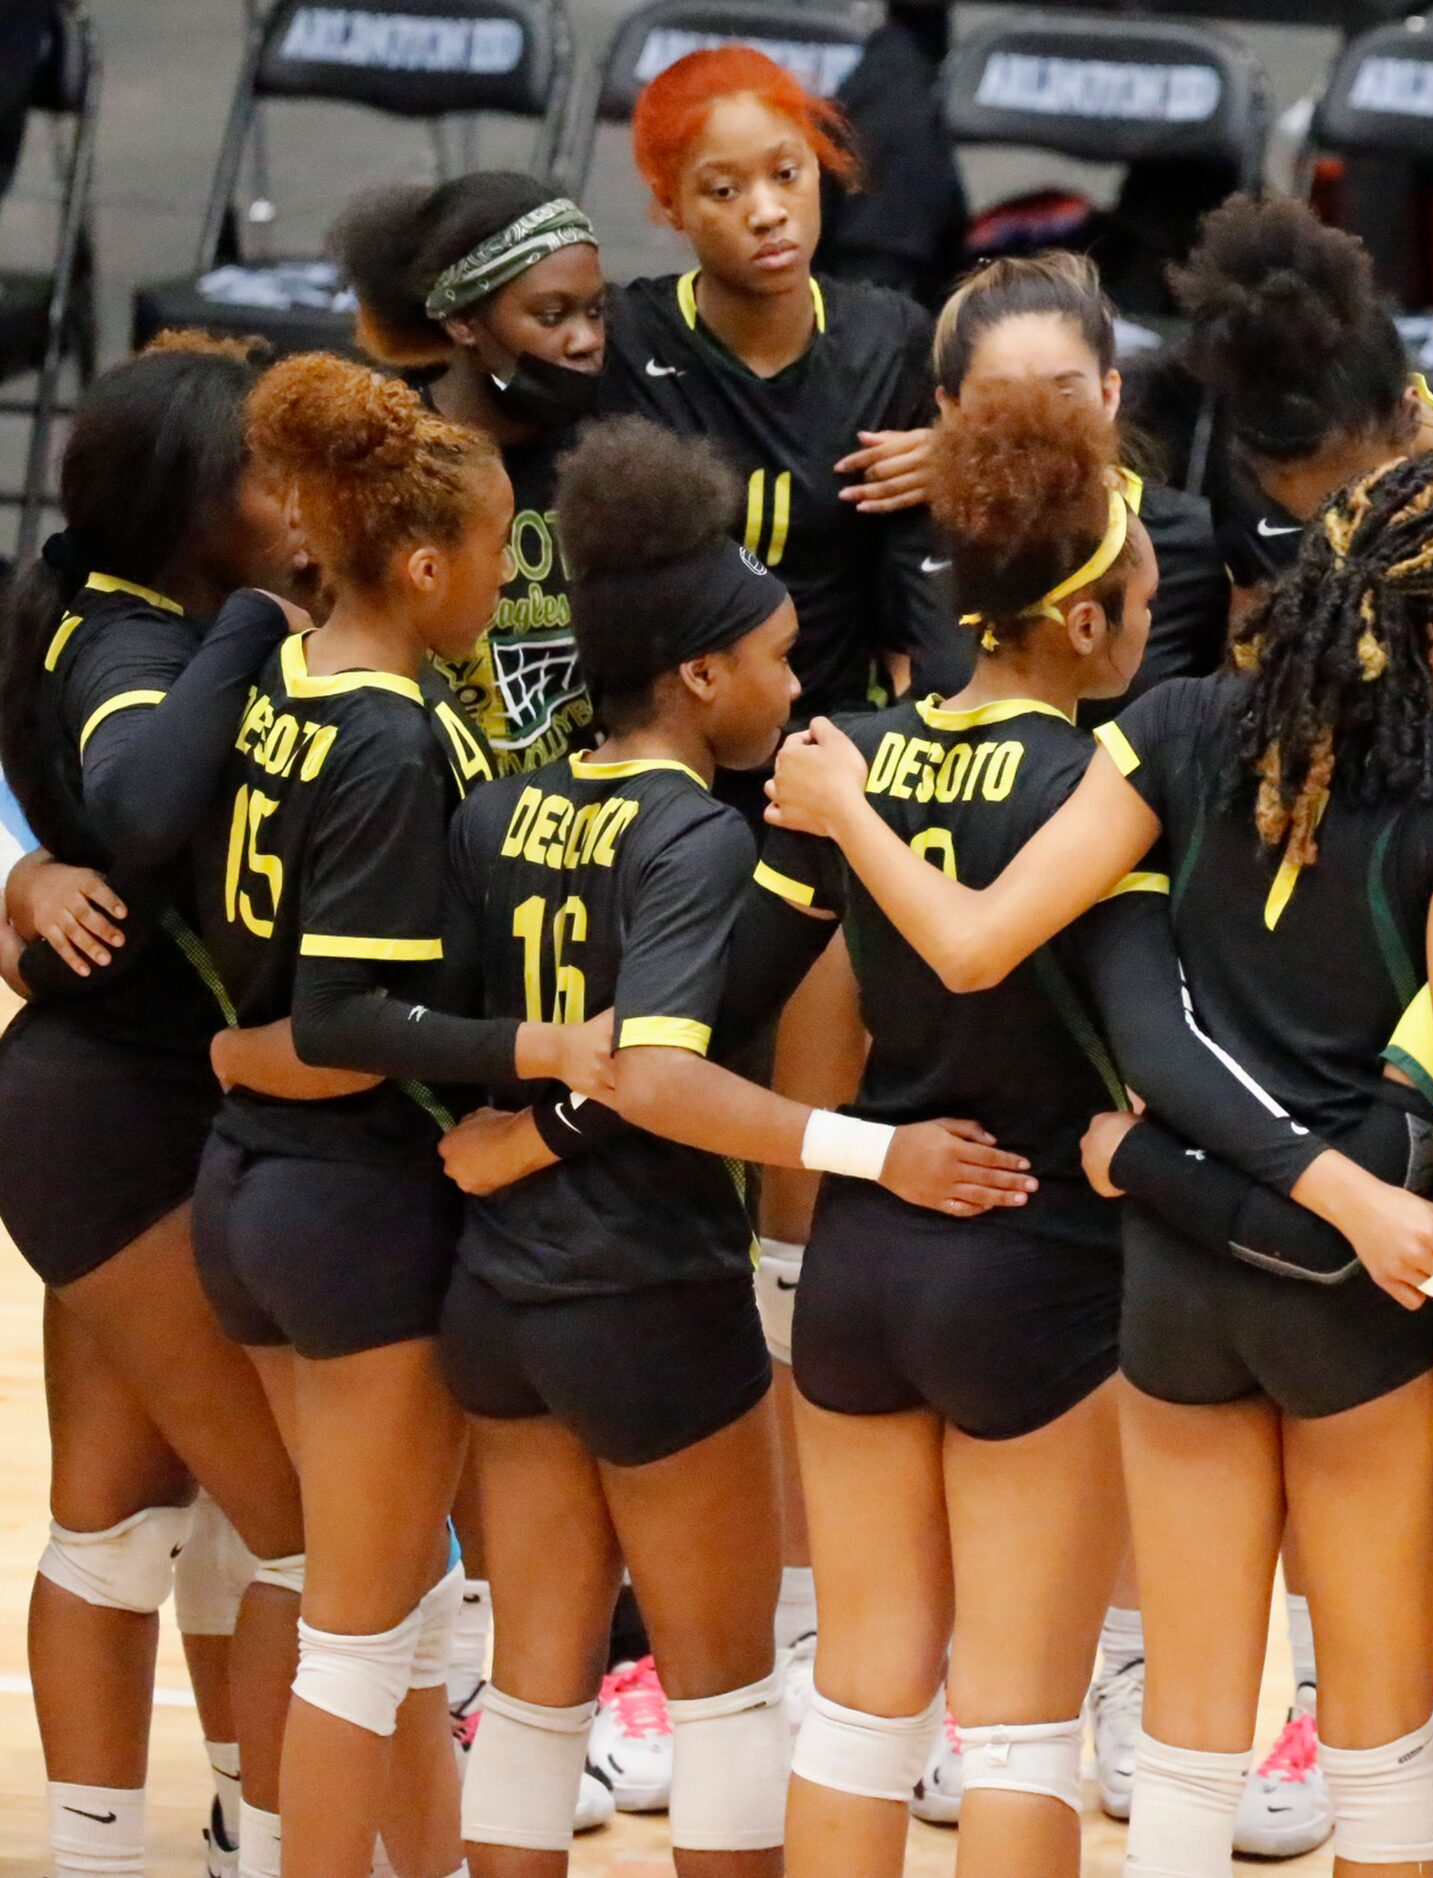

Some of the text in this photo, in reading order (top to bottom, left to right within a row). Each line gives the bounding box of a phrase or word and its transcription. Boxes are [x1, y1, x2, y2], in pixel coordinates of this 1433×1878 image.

[744, 467, 792, 567] 11
[488, 582, 571, 635] agles
[866, 731, 1025, 804] DESOTO
[225, 783, 283, 939] 15
[512, 894, 588, 1025] 16
